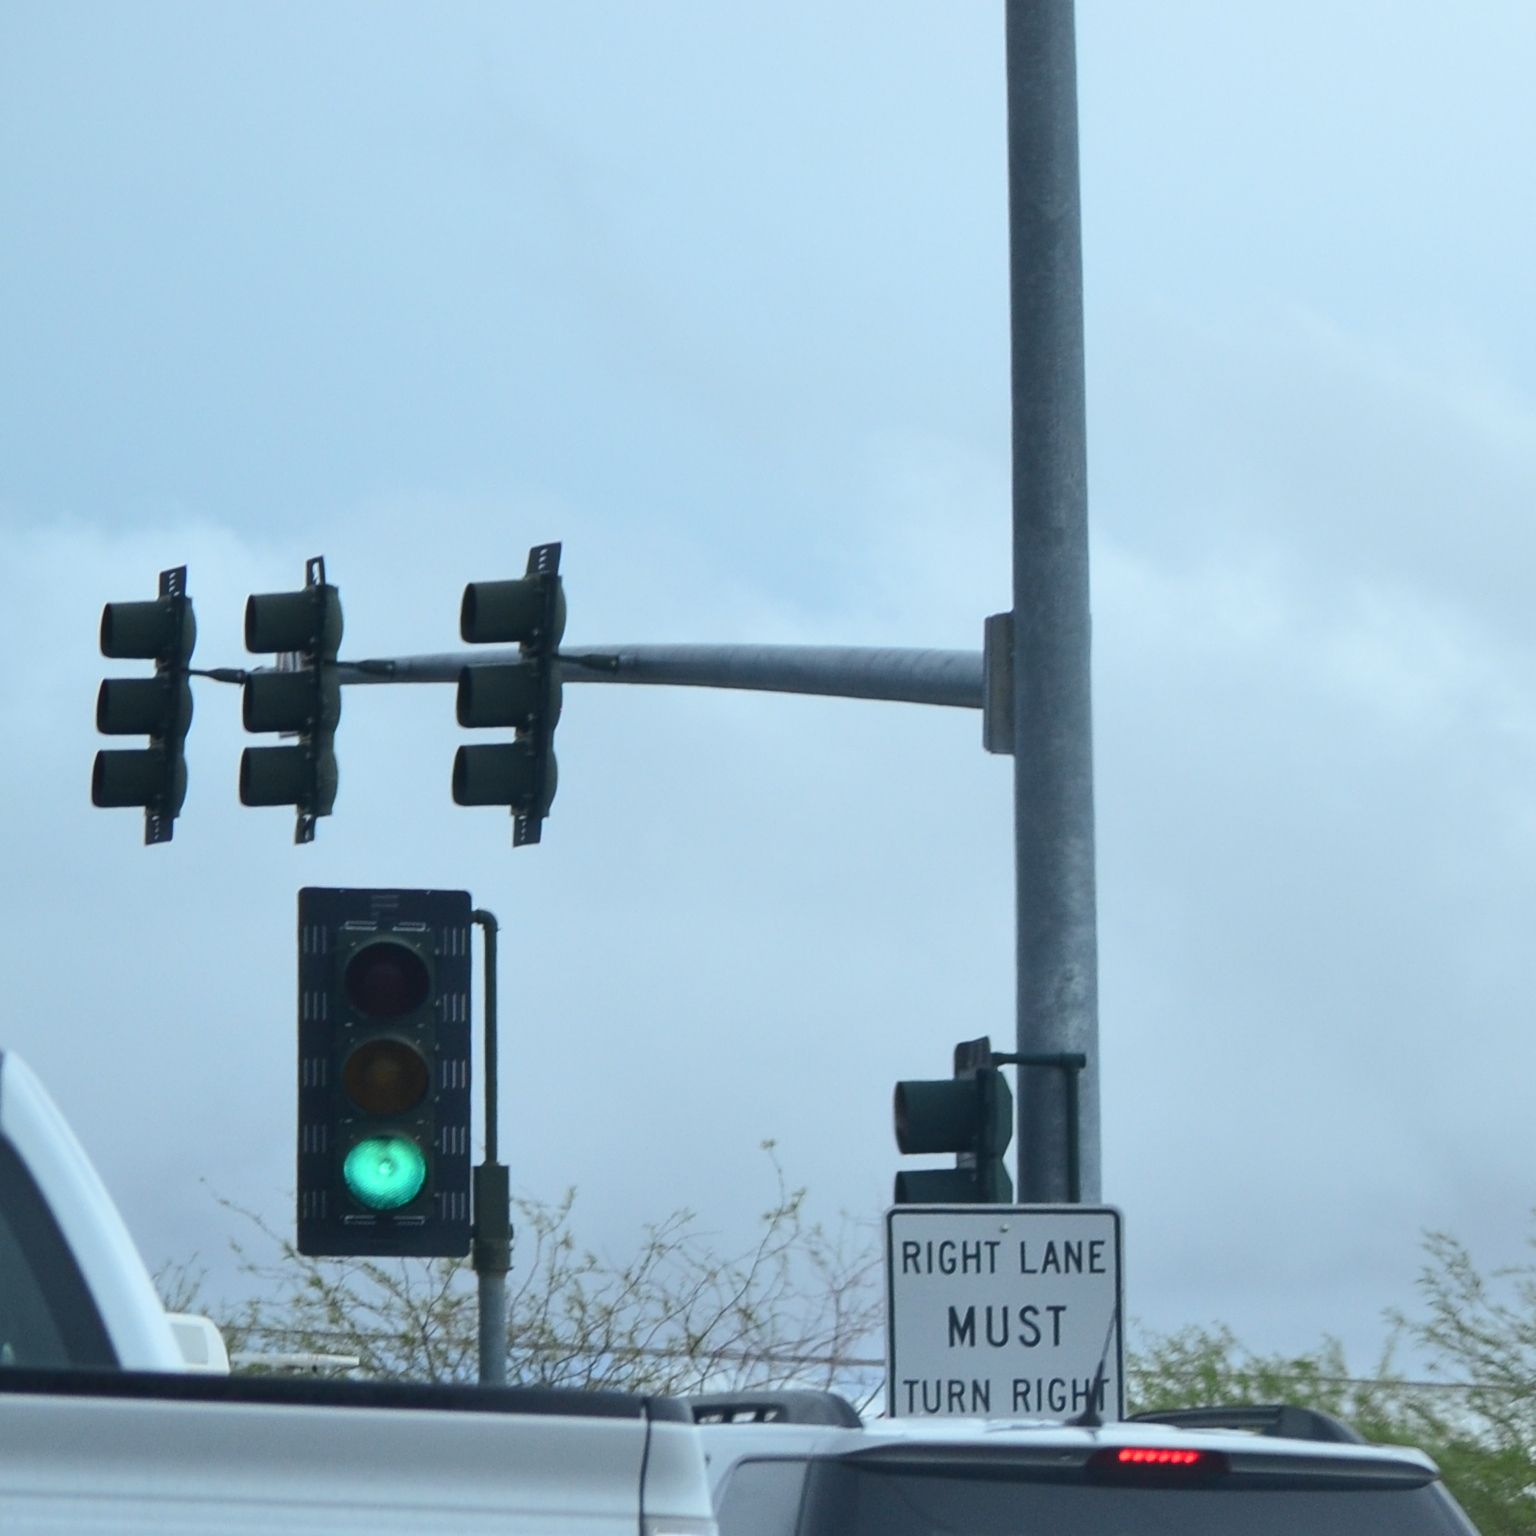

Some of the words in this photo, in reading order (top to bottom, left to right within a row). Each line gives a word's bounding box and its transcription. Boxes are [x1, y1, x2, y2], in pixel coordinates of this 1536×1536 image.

[902, 1240, 1000, 1275] RIGHT
[1020, 1240, 1106, 1274] LANE
[948, 1305, 1067, 1348] MUST
[903, 1379, 990, 1414] TURN
[1012, 1379, 1110, 1413] RIGHT
